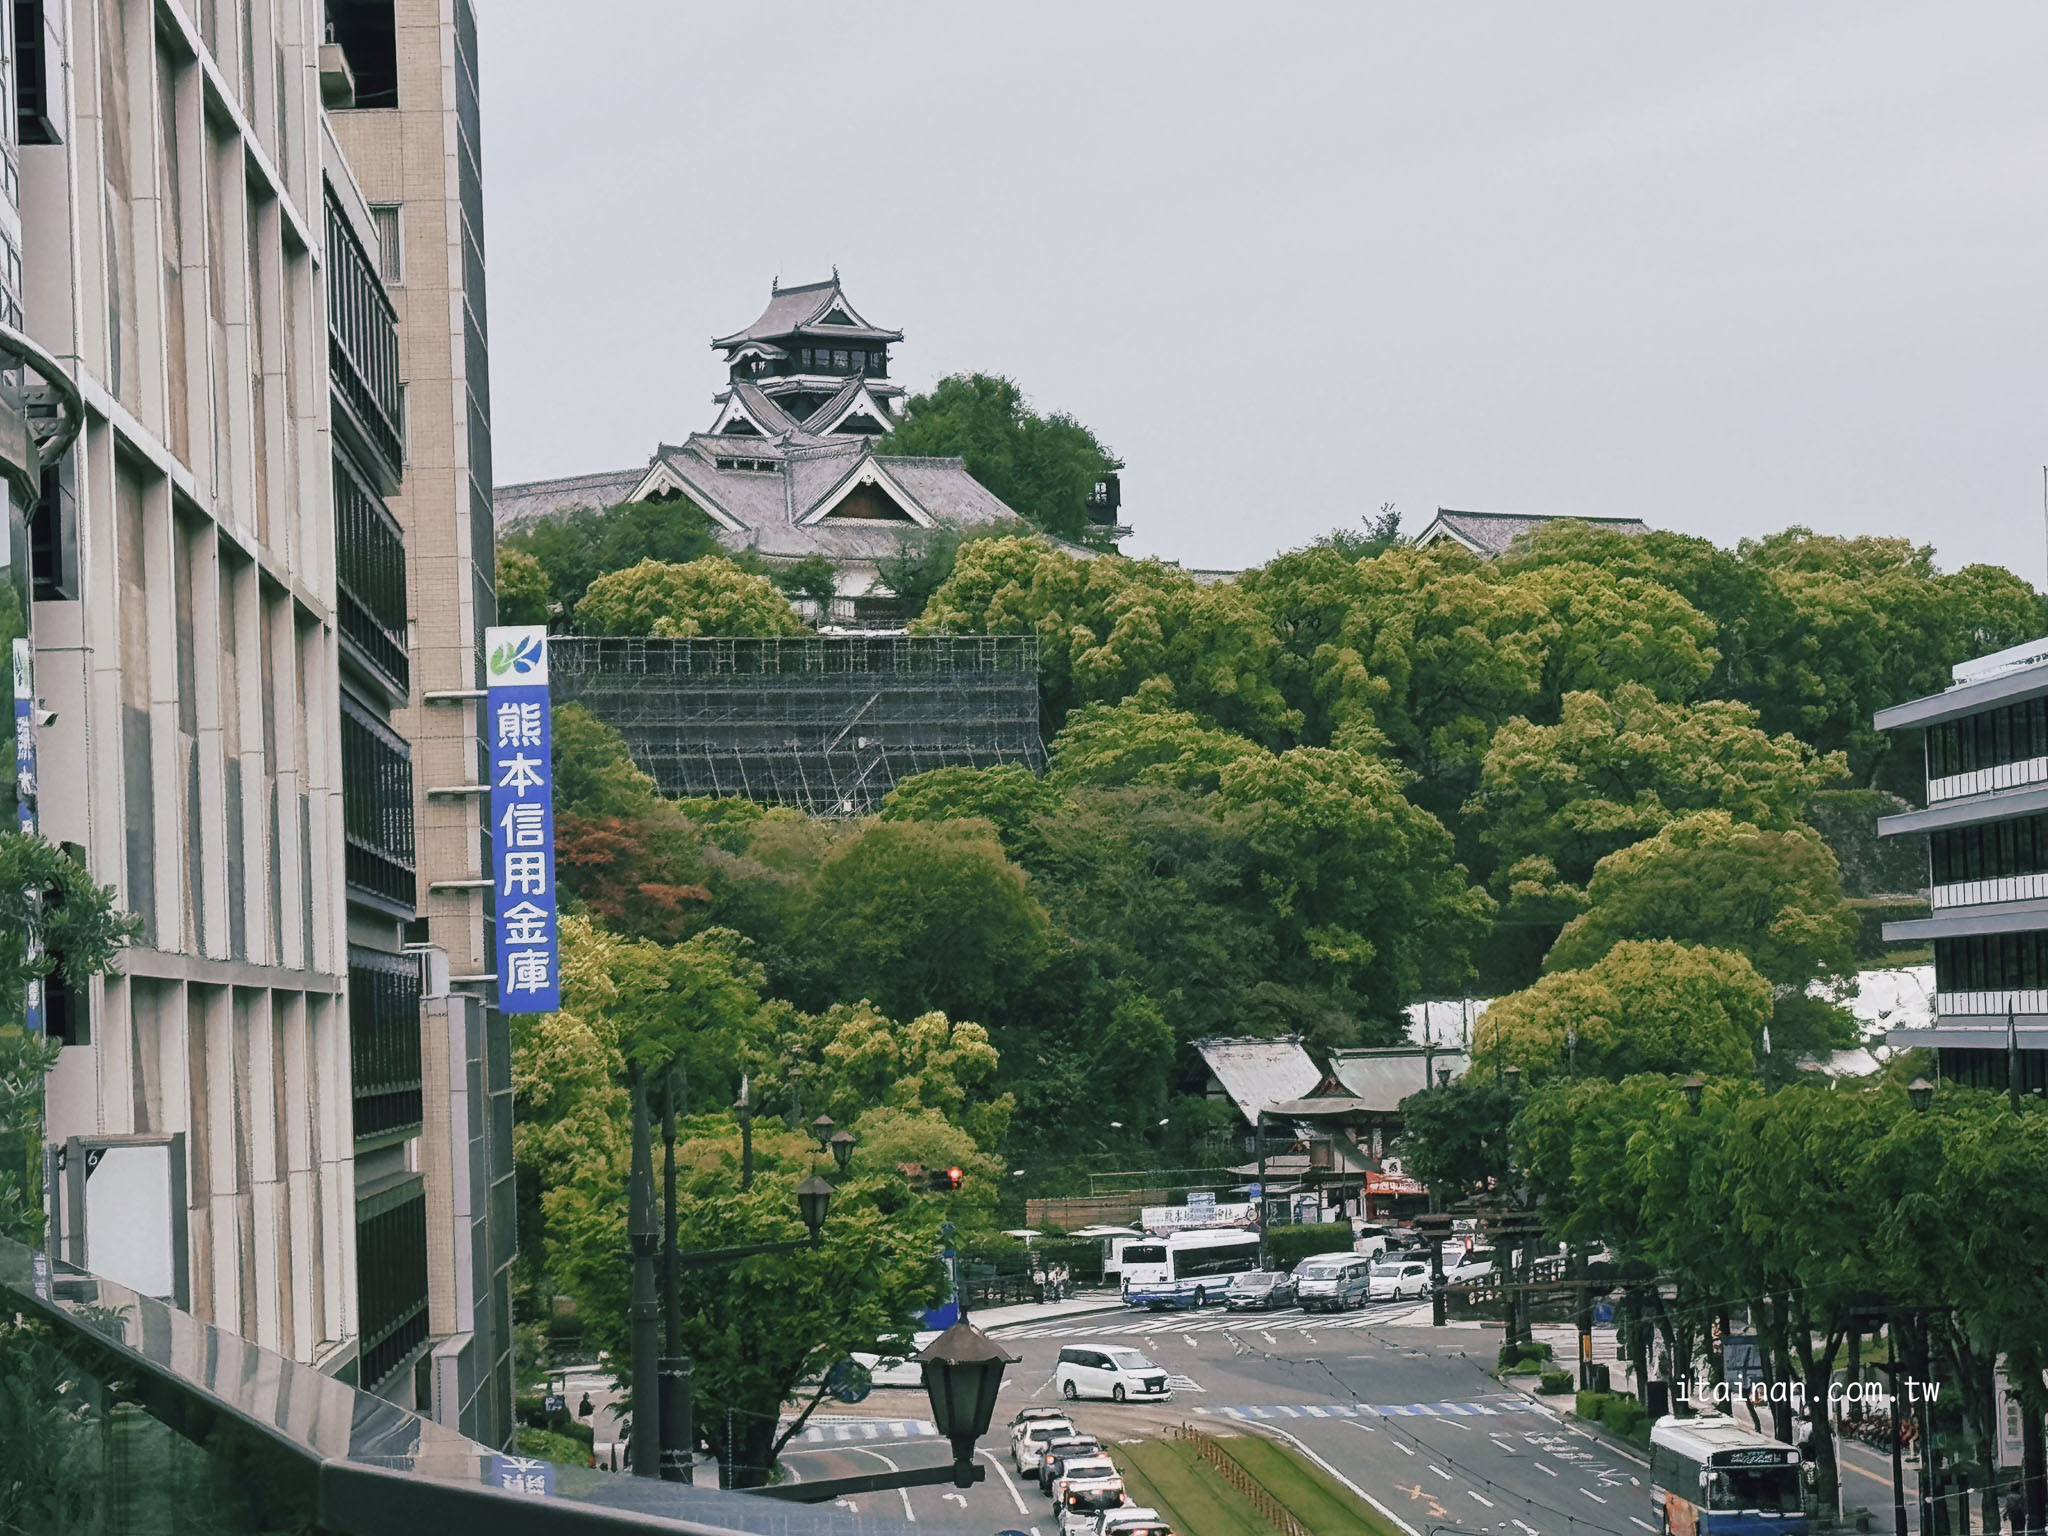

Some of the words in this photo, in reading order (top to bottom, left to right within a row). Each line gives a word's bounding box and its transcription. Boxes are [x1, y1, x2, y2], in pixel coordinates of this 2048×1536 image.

[497, 702, 551, 995] 熊本信用金庫
